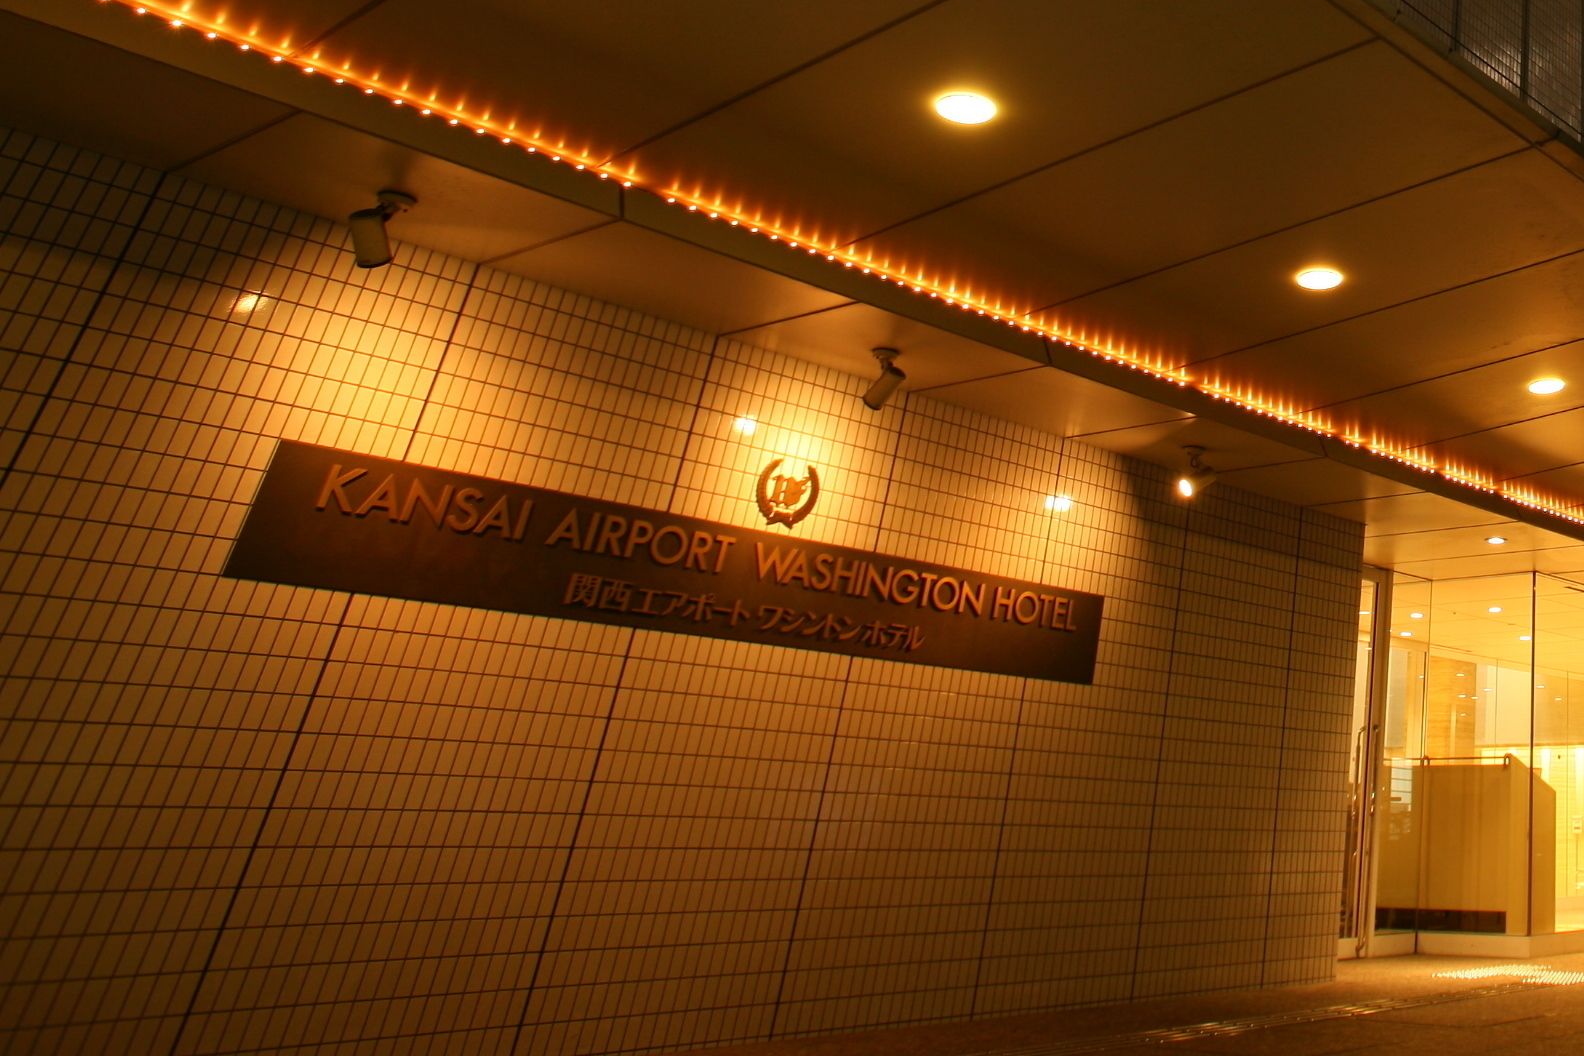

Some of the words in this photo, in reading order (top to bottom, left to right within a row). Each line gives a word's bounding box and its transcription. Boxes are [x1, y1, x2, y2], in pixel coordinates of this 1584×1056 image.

[315, 464, 533, 540] KANSAI
[546, 508, 736, 574] AIRPORT
[755, 542, 984, 617] WASHINGTON
[992, 585, 1076, 633] HOTEL
